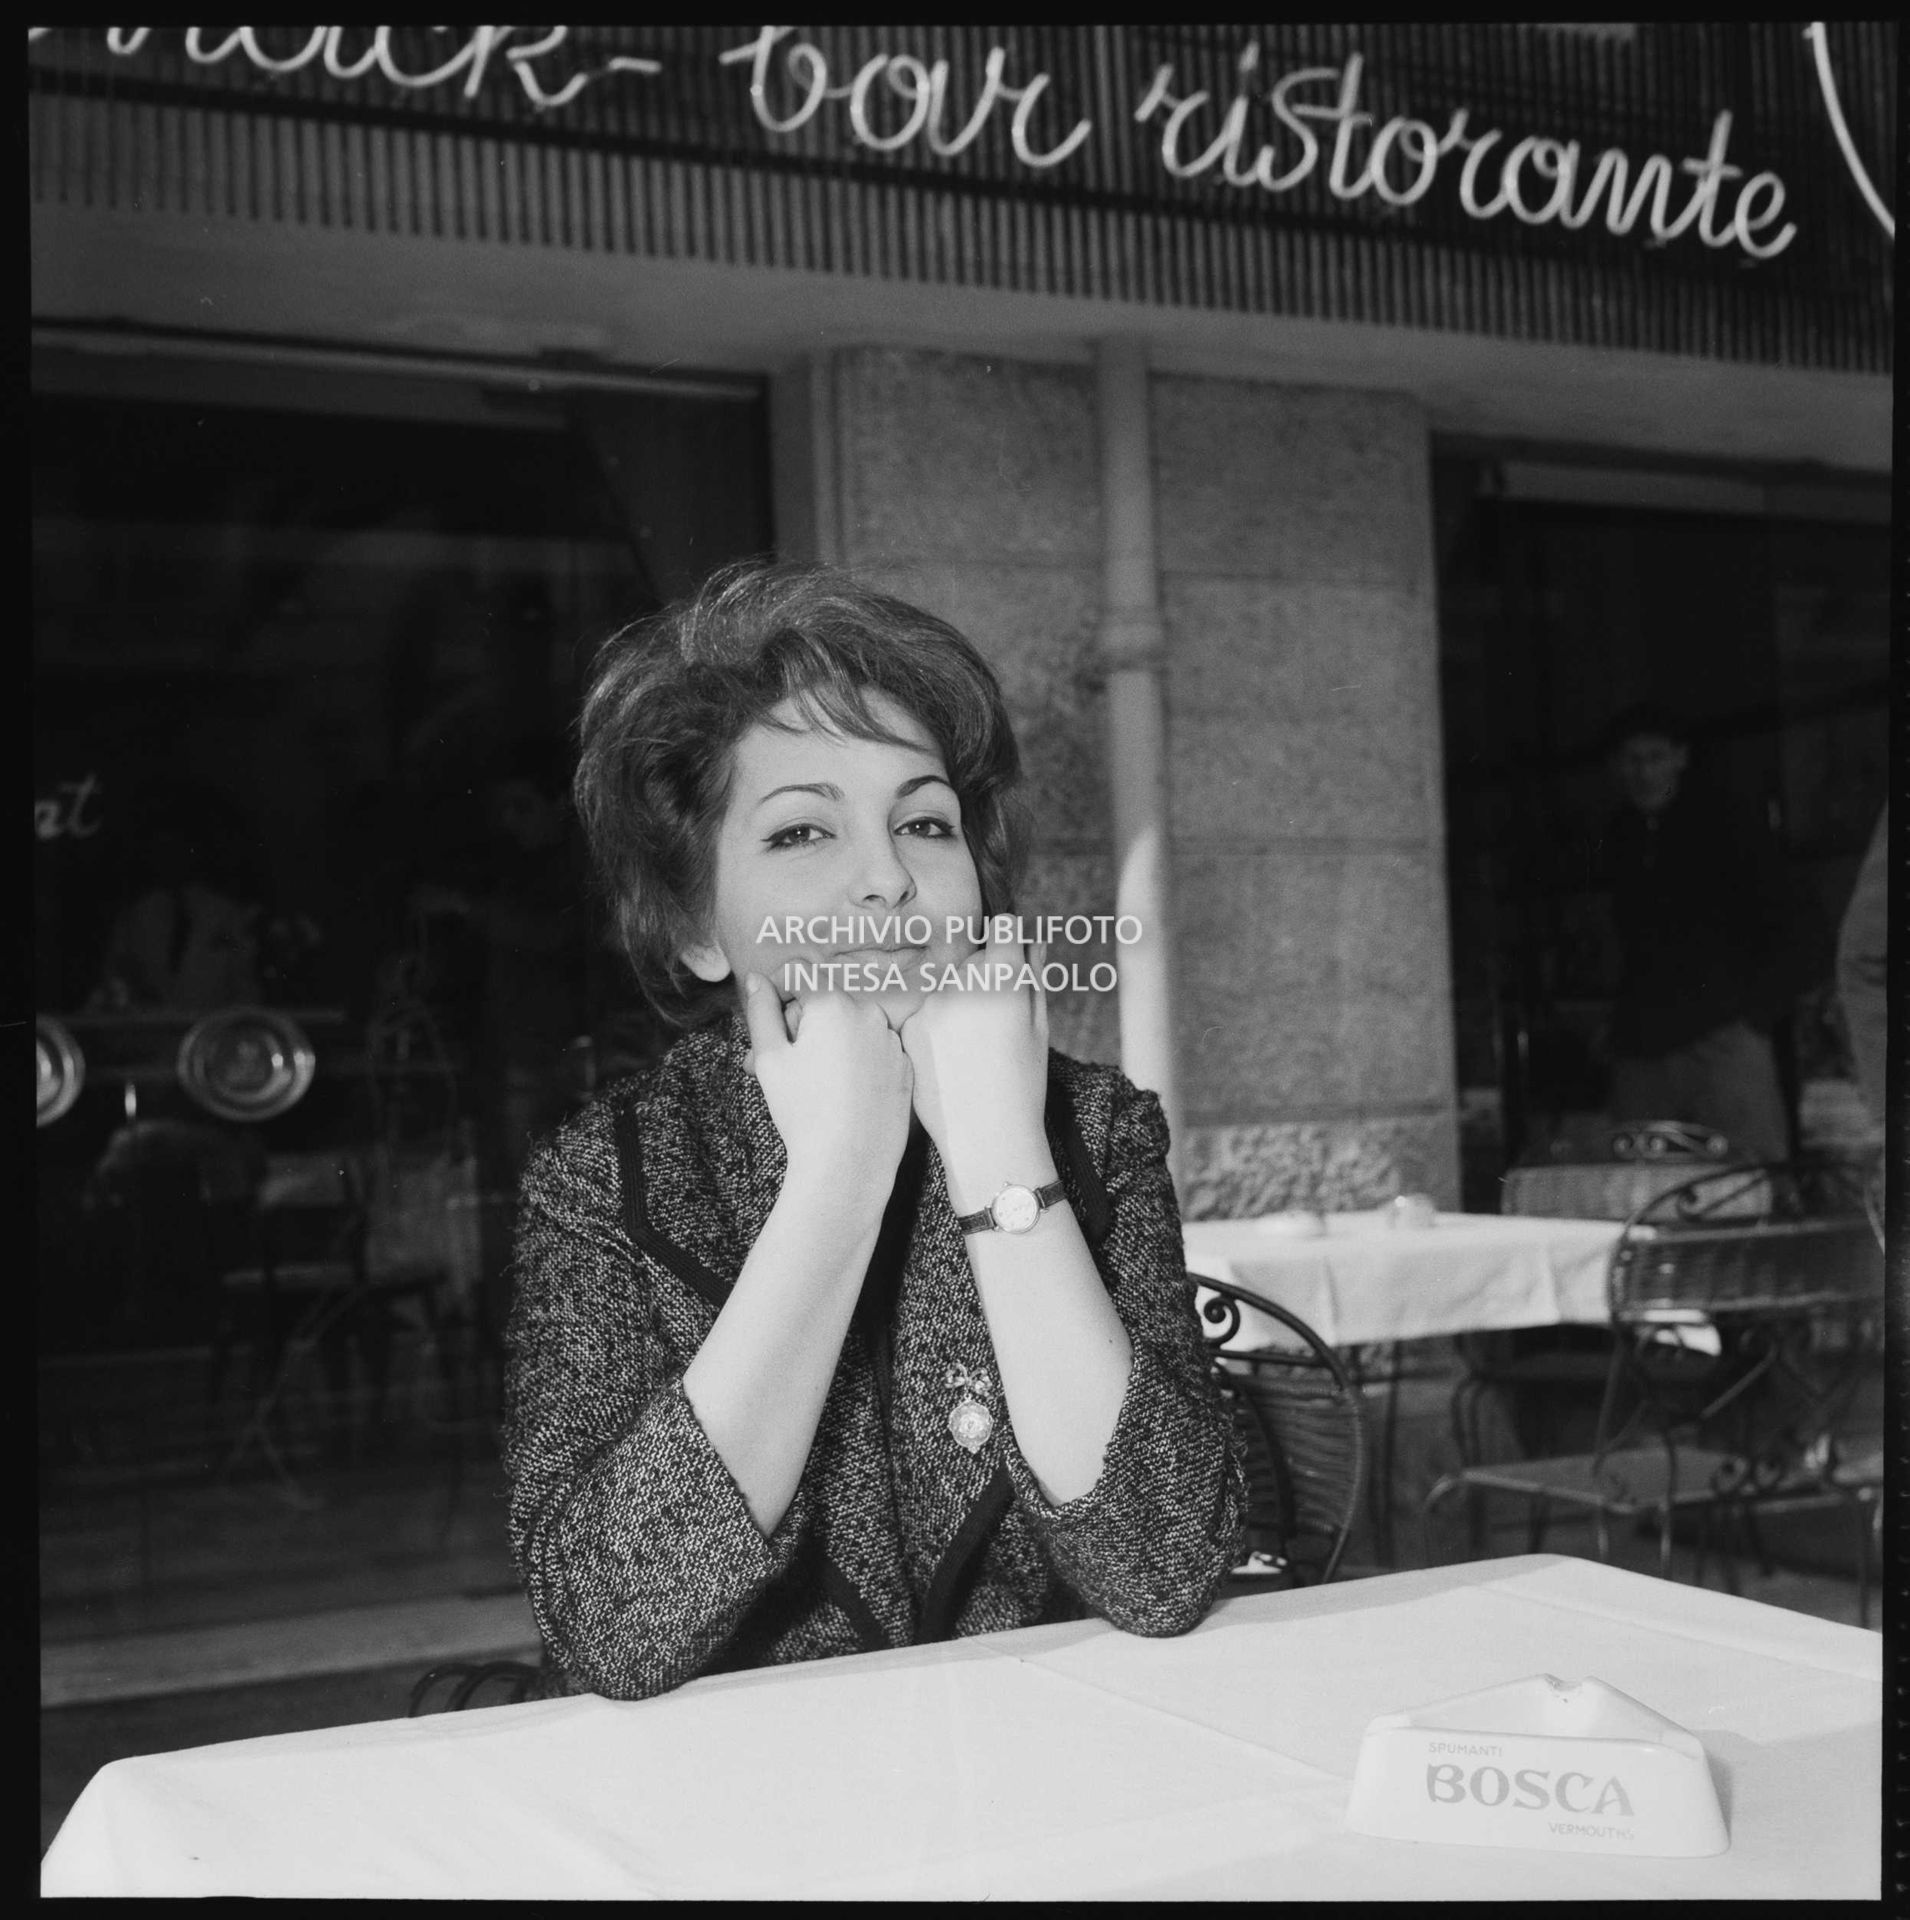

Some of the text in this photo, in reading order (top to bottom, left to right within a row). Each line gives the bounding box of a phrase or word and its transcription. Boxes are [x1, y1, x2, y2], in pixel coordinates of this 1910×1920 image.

[720, 26, 1091, 167] bar
[1134, 41, 1797, 258] ristorante
[1428, 1742, 1503, 1757] SPUMANTI
[1426, 1763, 1635, 1817] BOSCA
